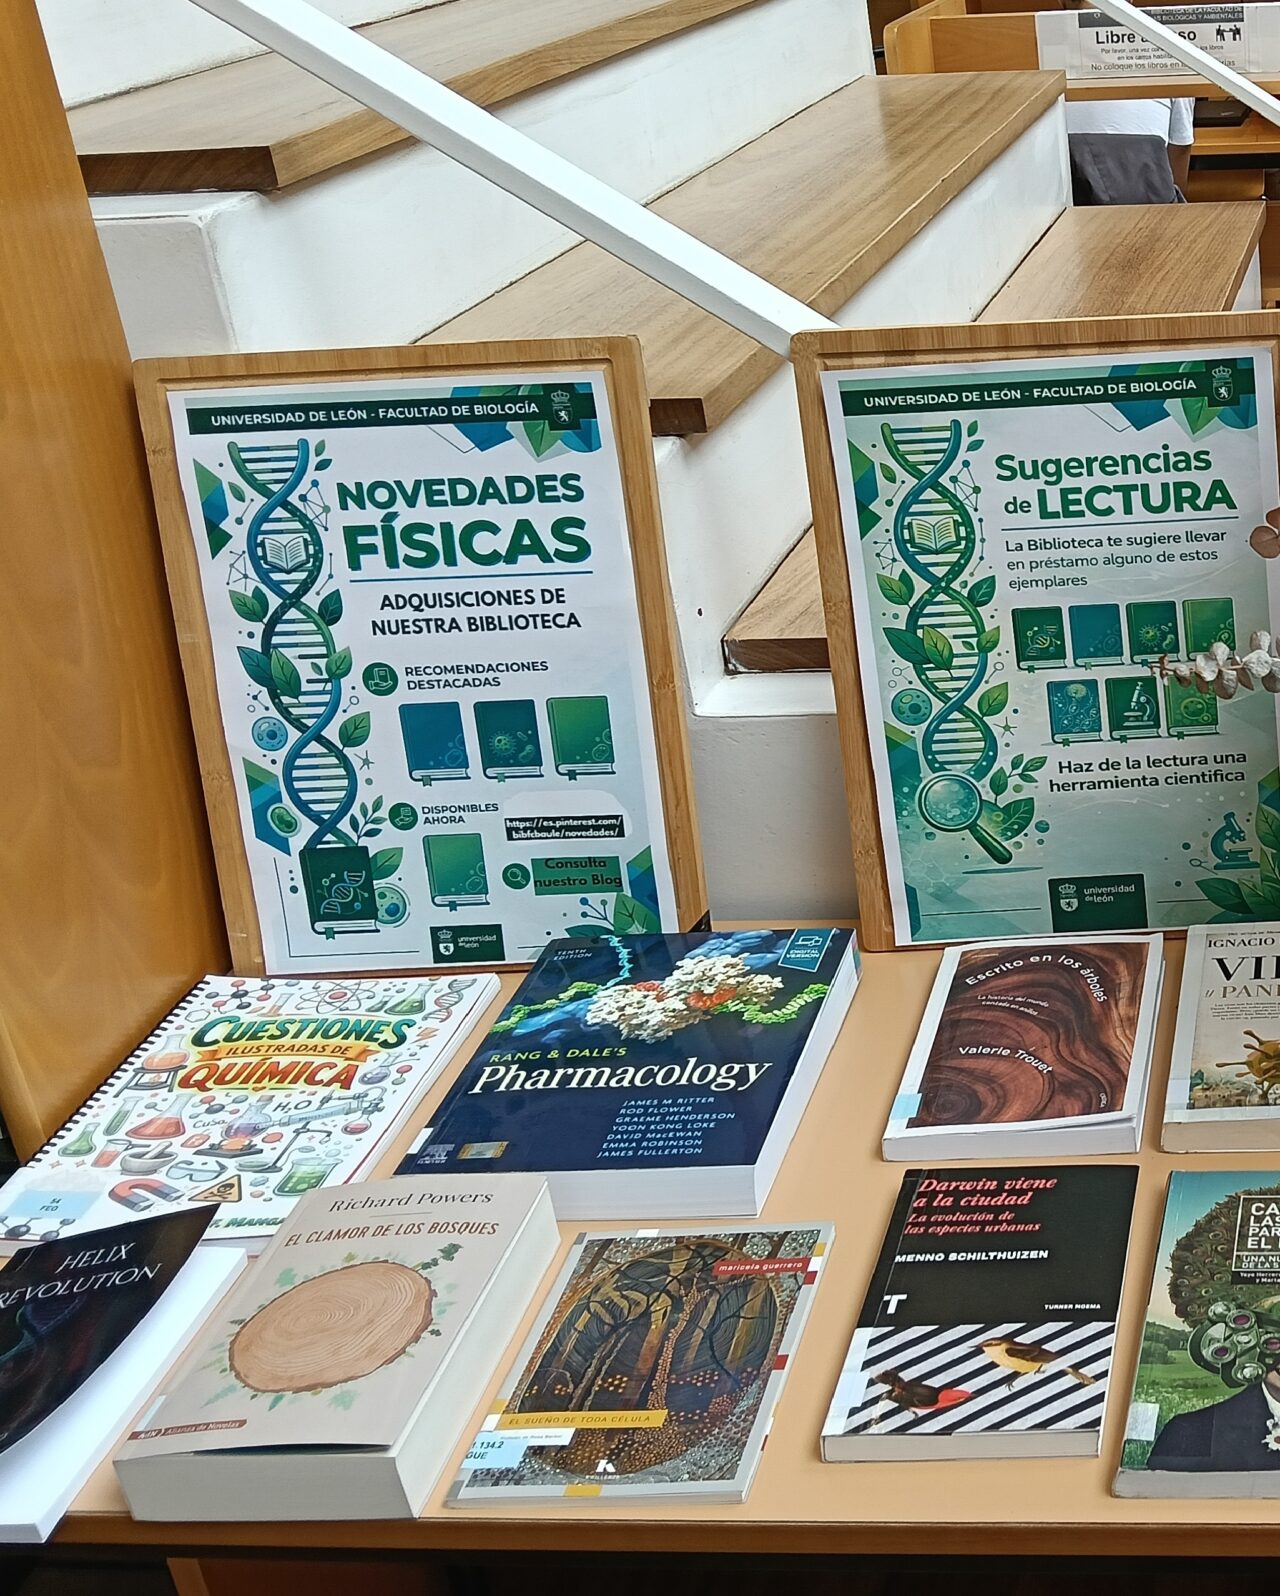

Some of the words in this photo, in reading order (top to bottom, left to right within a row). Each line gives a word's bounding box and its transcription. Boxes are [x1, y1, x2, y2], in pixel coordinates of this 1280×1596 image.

[1096, 31, 1135, 44] Libre
[1104, 62, 1133, 71] coloque
[211, 411, 305, 427] UNIVERSIDAD
[308, 409, 328, 422] DE
[332, 406, 367, 422] LEÓN
[378, 404, 448, 420] FACULTAD
[452, 403, 470, 416] DE
[474, 400, 539, 416] BIOLOGÍA
[995, 444, 1212, 485] Sugerencias
[336, 473, 585, 511] NOVEDADES
[1004, 496, 1032, 515] de
[1036, 479, 1238, 520] LECTURA
[342, 510, 592, 572] FÍSICAS
[1005, 537, 1023, 552] La
[1027, 532, 1103, 551] Biblioteca
[1107, 533, 1121, 546] te
[1126, 531, 1181, 549] sugiere
[1184, 528, 1227, 543] llevar
[1006, 559, 1025, 571] en
[1029, 553, 1099, 572] préstamo
[1103, 552, 1153, 570] alguno
[1156, 549, 1174, 562] de
[1179, 548, 1218, 562] estos
[1008, 573, 1088, 591] ejemplares
[379, 589, 536, 612] ADQUISICIONES
[541, 588, 566, 606] DE
[371, 615, 463, 636] NUESTRA
[467, 612, 582, 634] BIBLIOTECA
[405, 661, 549, 677] RECOMENDACIONES
[407, 677, 501, 691] DESTACADAS
[1058, 761, 1094, 774] Haz
[1098, 759, 1121, 771] de
[1126, 757, 1141, 769] la
[1146, 754, 1208, 768] lectura
[1213, 753, 1247, 764] una
[1049, 774, 1159, 792] herramienta
[1164, 768, 1245, 785] cientifica
[422, 802, 499, 814] DISPONIBLES
[423, 815, 466, 825] AHORA
[545, 856, 607, 869] Consulta
[534, 876, 587, 887] nuestro
[592, 874, 623, 887] Blog
[1083, 883, 1135, 894] universidad
[1208, 937, 1275, 948] IGNACIO
[965, 959, 1024, 986] Escrito
[1030, 954, 1051, 963] en
[1058, 955, 1082, 969] los
[1080, 967, 1107, 1003] árboles
[191, 1015, 417, 1050] CUESTIONES
[226, 1044, 330, 1056] ILUSTRADAS
[331, 1046, 352, 1054] DE
[490, 1050, 541, 1063] RANG
[547, 1050, 559, 1058] &
[566, 1047, 628, 1058] DALE'S
[959, 1046, 1010, 1056] Valerie
[1015, 1049, 1054, 1074] Trouet
[178, 1057, 362, 1092] QUÍMICA
[468, 1057, 774, 1094] Pharmacology
[615, 1114, 662, 1123] GRAEME
[666, 1112, 735, 1122] HENDERSON
[918, 1178, 998, 1192] Darwin
[1004, 1177, 1057, 1189] viene
[329, 1193, 414, 1212] Richard
[417, 1193, 494, 1205] Powers
[913, 1197, 926, 1207] a
[933, 1194, 954, 1207] la
[960, 1192, 1033, 1206] ciudad
[285, 1234, 302, 1247] EL
[305, 1226, 370, 1244] CLAMOR
[371, 1224, 395, 1237] DE
[395, 1223, 424, 1235] LOS
[427, 1222, 499, 1235] BOSQUES
[1247, 1237, 1271, 1249] EL
[55, 1242, 136, 1274] HELIX
[895, 1252, 945, 1262] MENNO
[948, 1250, 1049, 1261] SCHILTHUIZEN
[763, 1262, 802, 1271] guerrero
[0, 1263, 162, 1309] REVOLUTION
[883, 1294, 907, 1314] T
[524, 1416, 560, 1424] SUEÑO
[611, 1414, 651, 1423] CÉLULA
